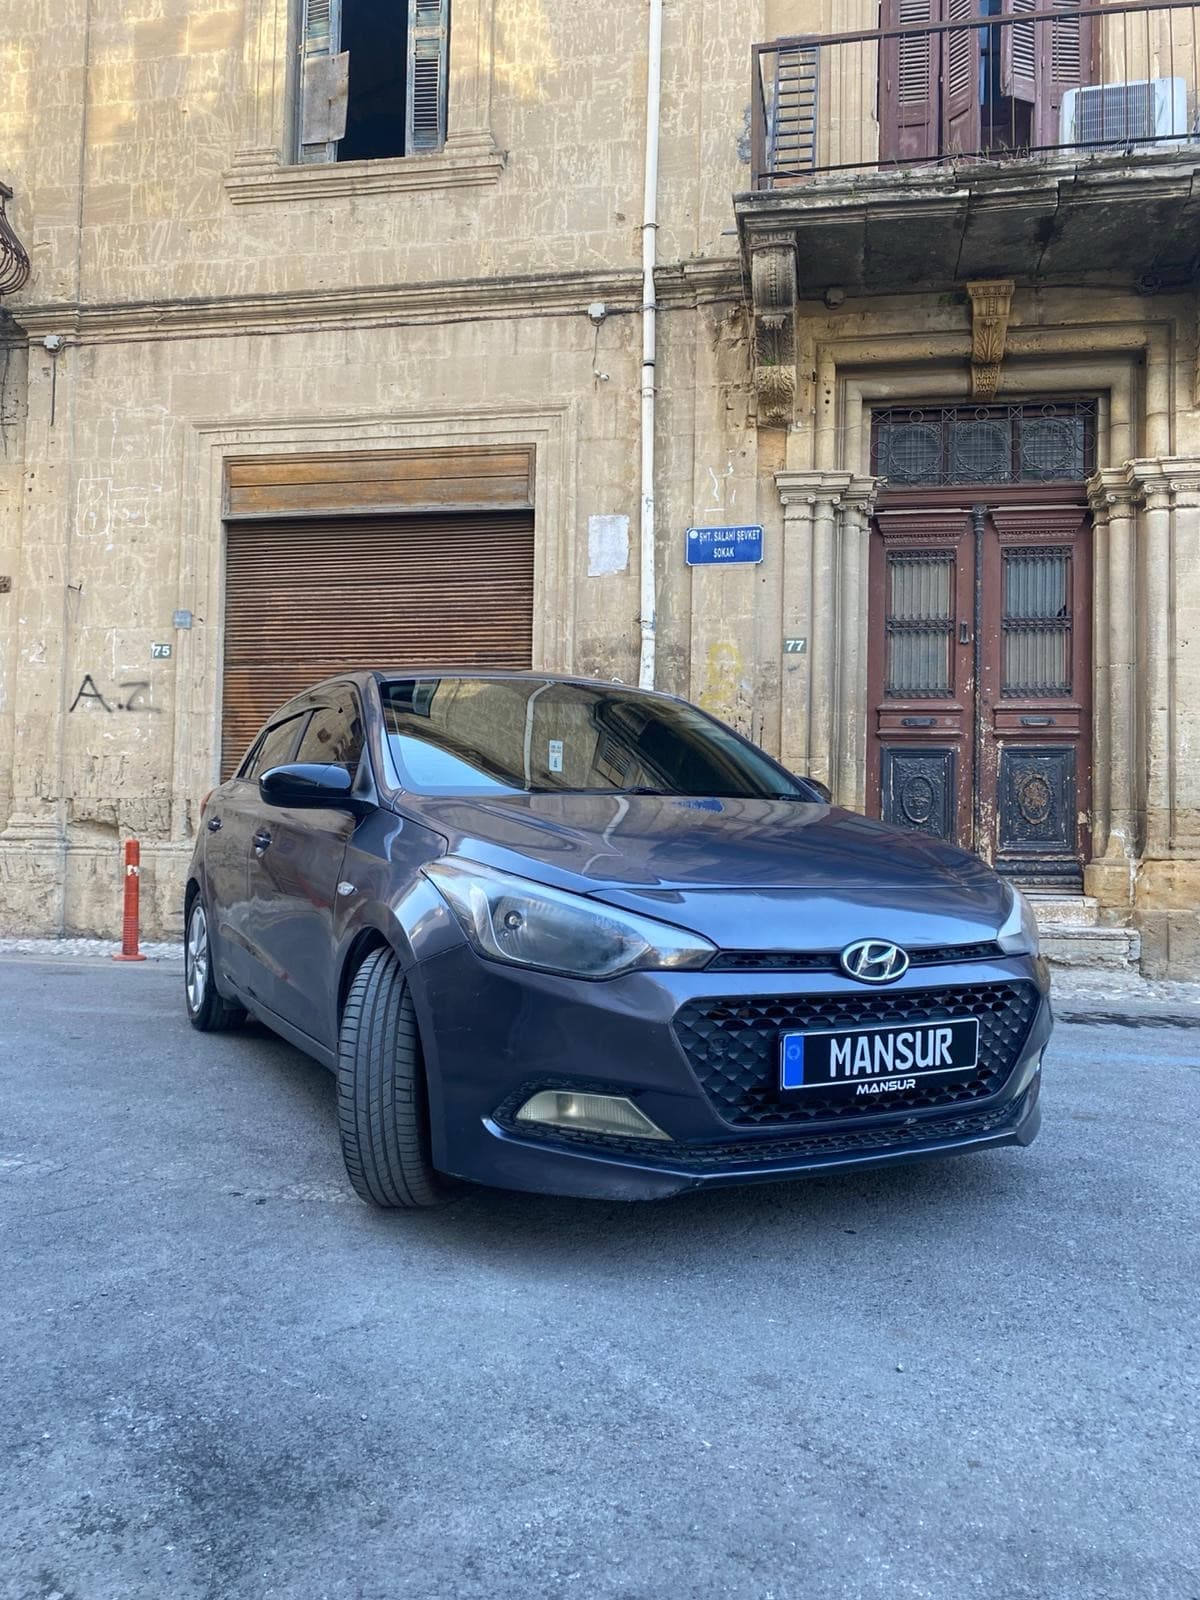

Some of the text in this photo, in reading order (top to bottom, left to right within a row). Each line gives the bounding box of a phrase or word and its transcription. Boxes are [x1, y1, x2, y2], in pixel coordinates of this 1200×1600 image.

[736, 529, 760, 543] ŞEVKET
[713, 546, 735, 558] SOKAK
[153, 645, 170, 656] 75
[786, 640, 804, 652] 77
[829, 1027, 953, 1078] MANSUR
[856, 1079, 916, 1095] MANSUR
